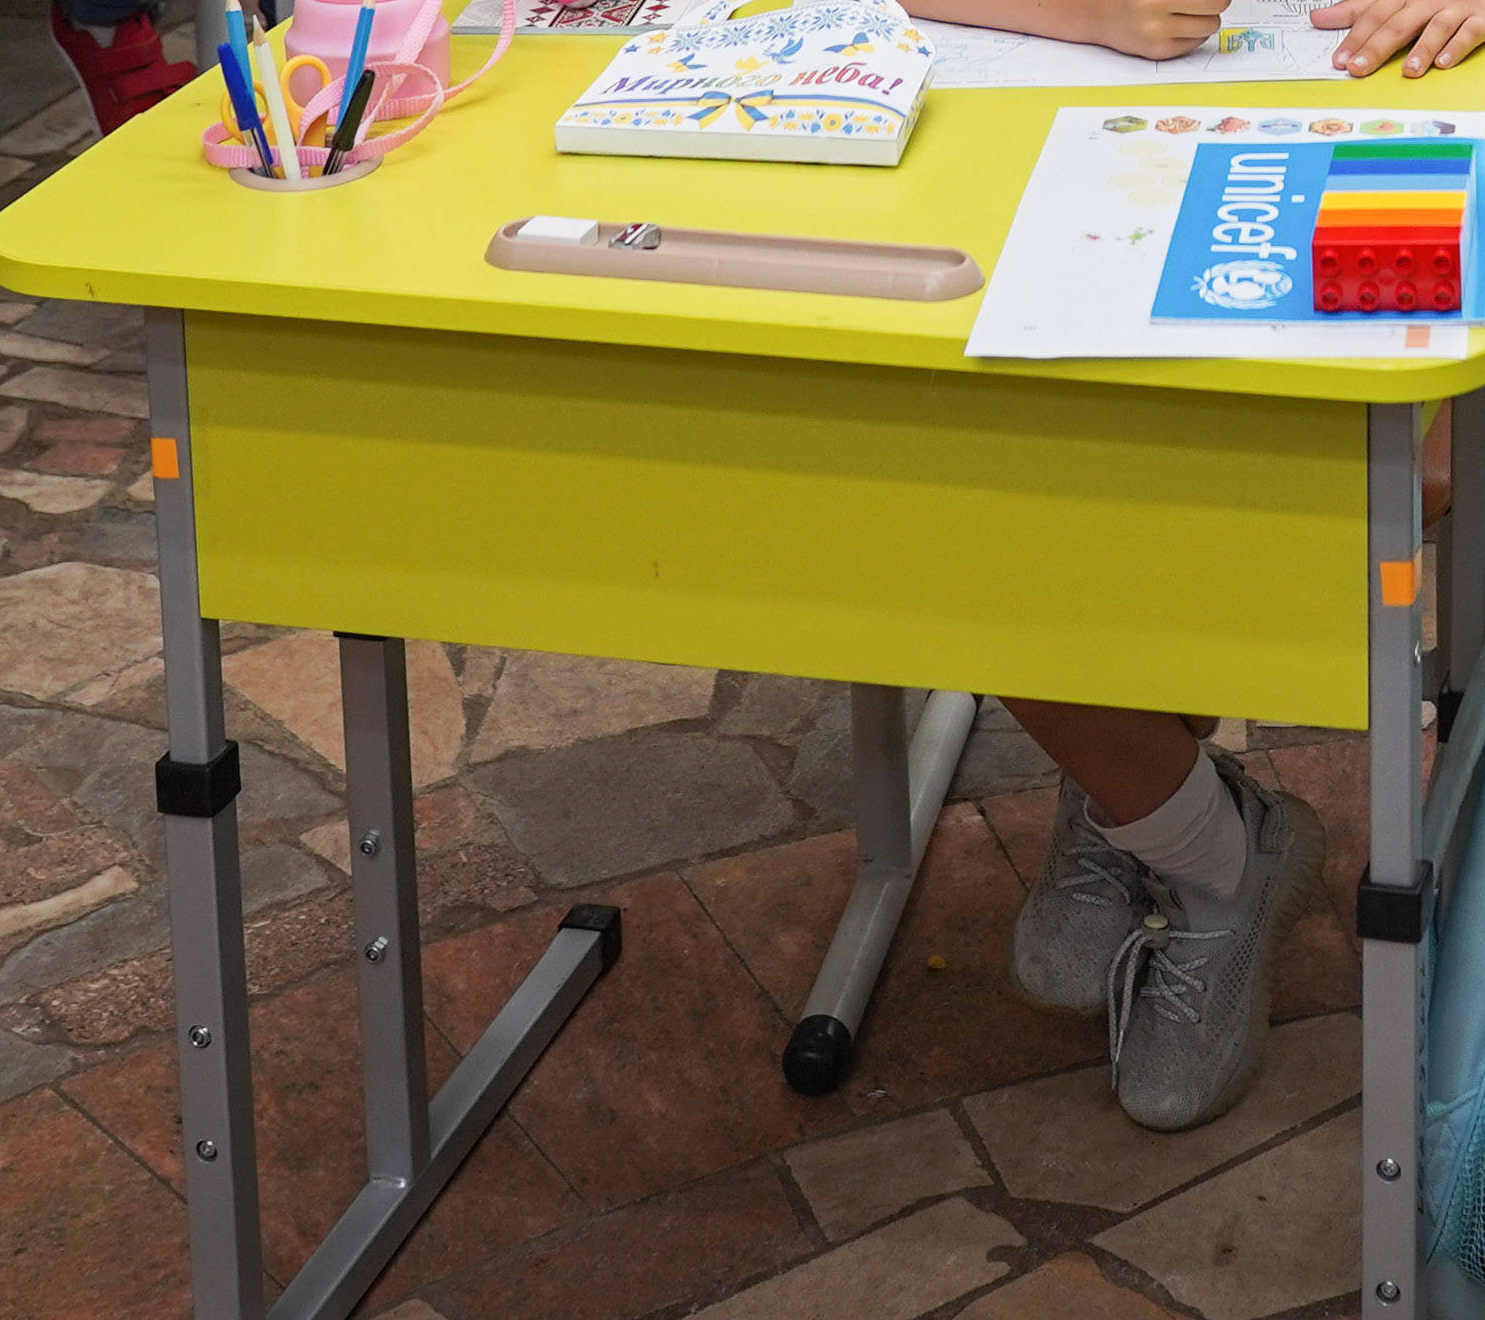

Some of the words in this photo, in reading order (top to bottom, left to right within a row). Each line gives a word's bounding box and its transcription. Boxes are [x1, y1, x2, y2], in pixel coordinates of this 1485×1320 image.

[603, 72, 783, 96] Мирного
[789, 62, 903, 96] неба!
[1209, 150, 1305, 261] unicef
